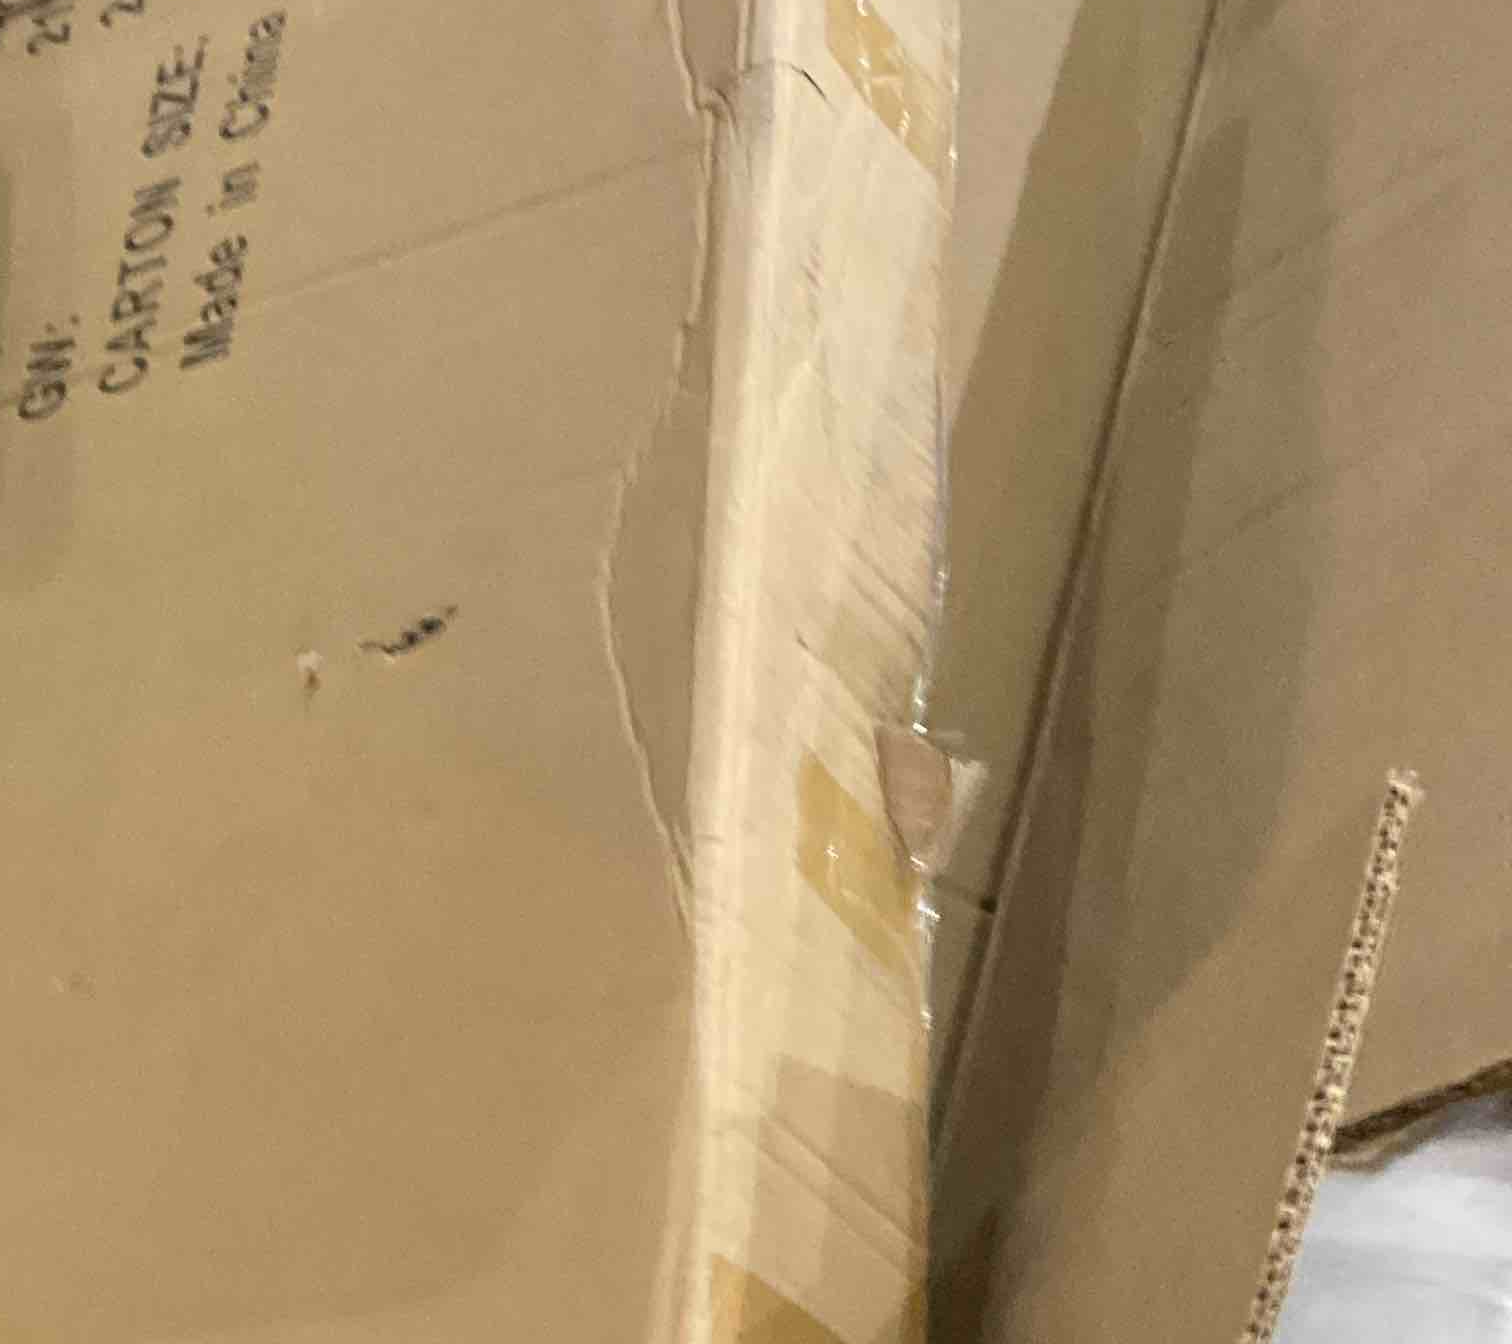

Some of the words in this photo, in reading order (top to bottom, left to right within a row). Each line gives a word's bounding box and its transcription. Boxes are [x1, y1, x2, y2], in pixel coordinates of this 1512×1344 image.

[220, 10, 284, 141] China
[98, 177, 181, 393] CARTON
[142, 35, 208, 157] SIZE:
[205, 162, 259, 215] in
[18, 313, 79, 420] GW:
[180, 235, 247, 371] Made
